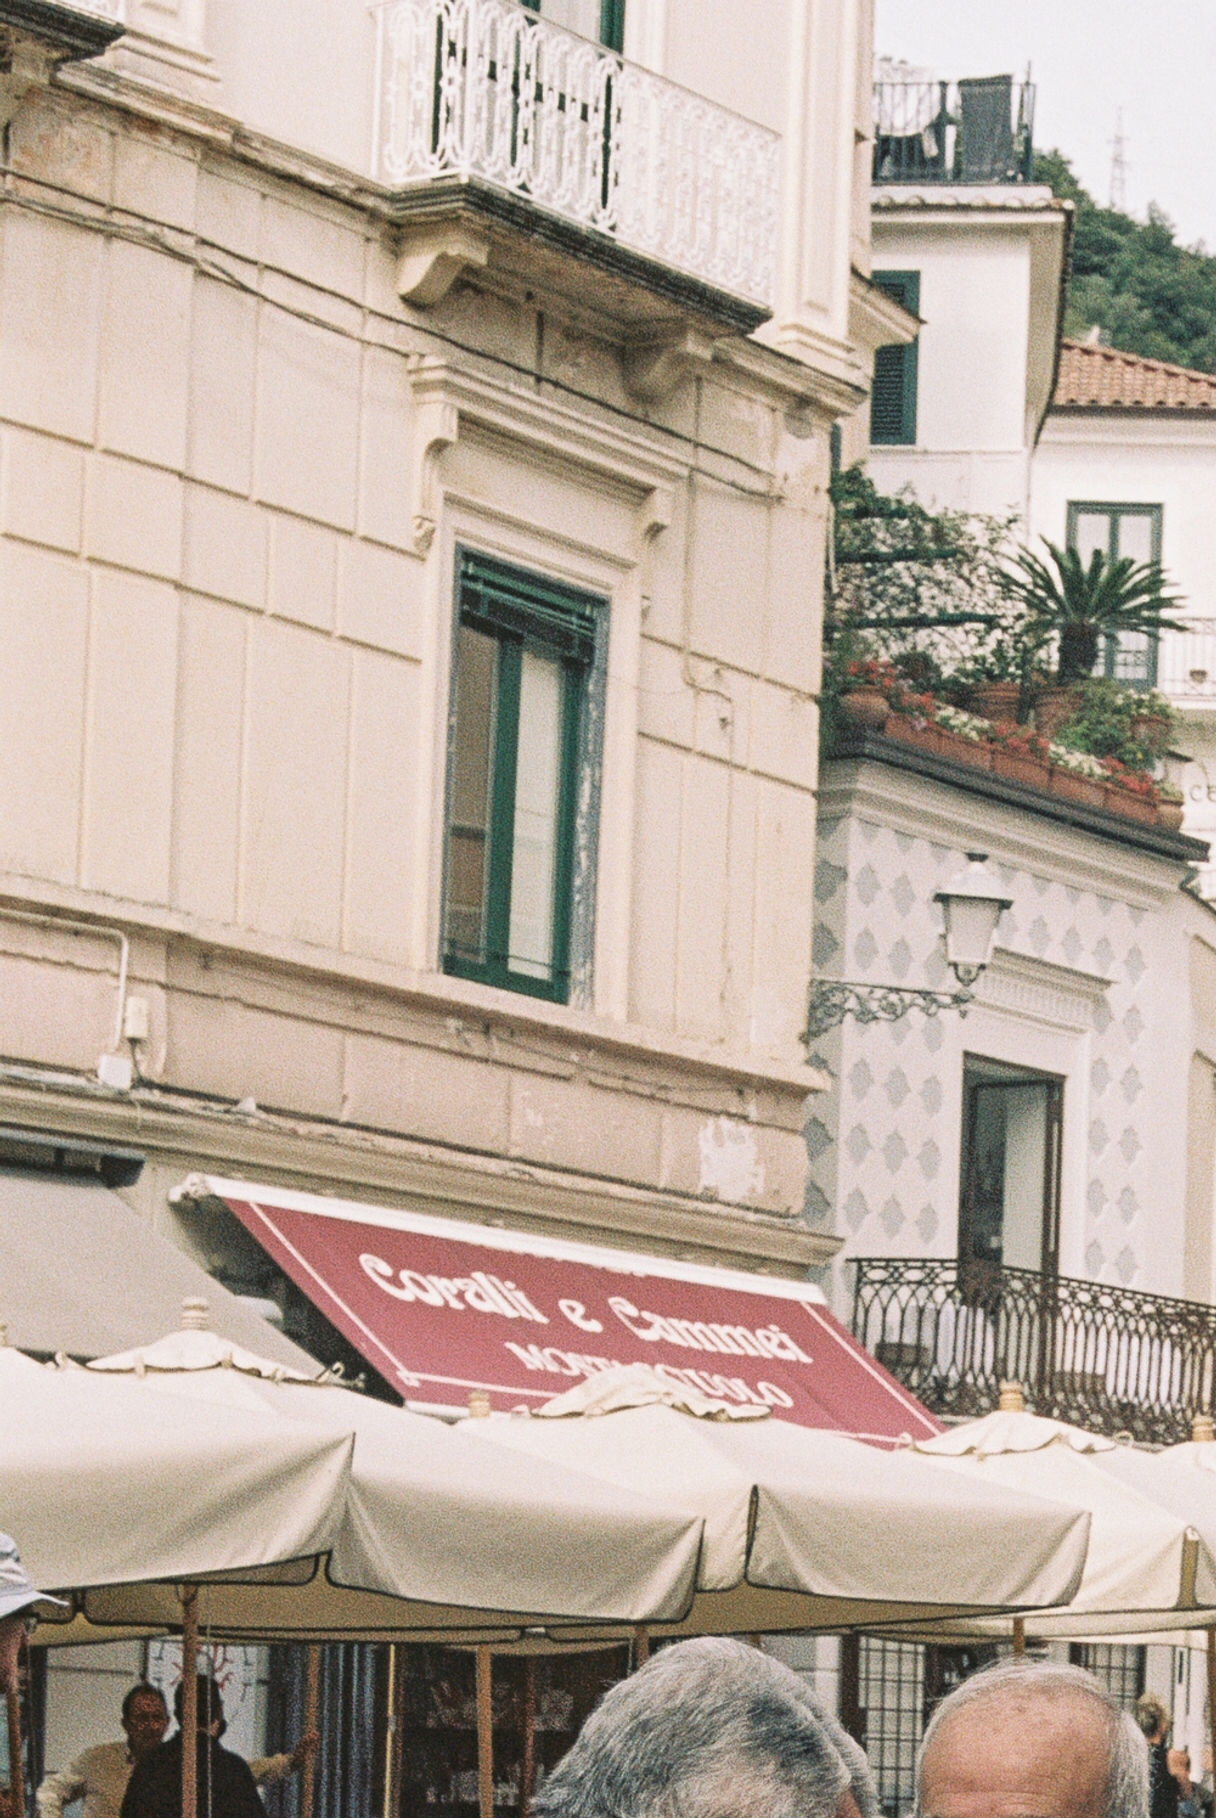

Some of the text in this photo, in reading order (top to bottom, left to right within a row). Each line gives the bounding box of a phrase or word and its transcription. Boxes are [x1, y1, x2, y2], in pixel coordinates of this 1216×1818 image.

[359, 1254, 813, 1364] Coralli e Cammei
